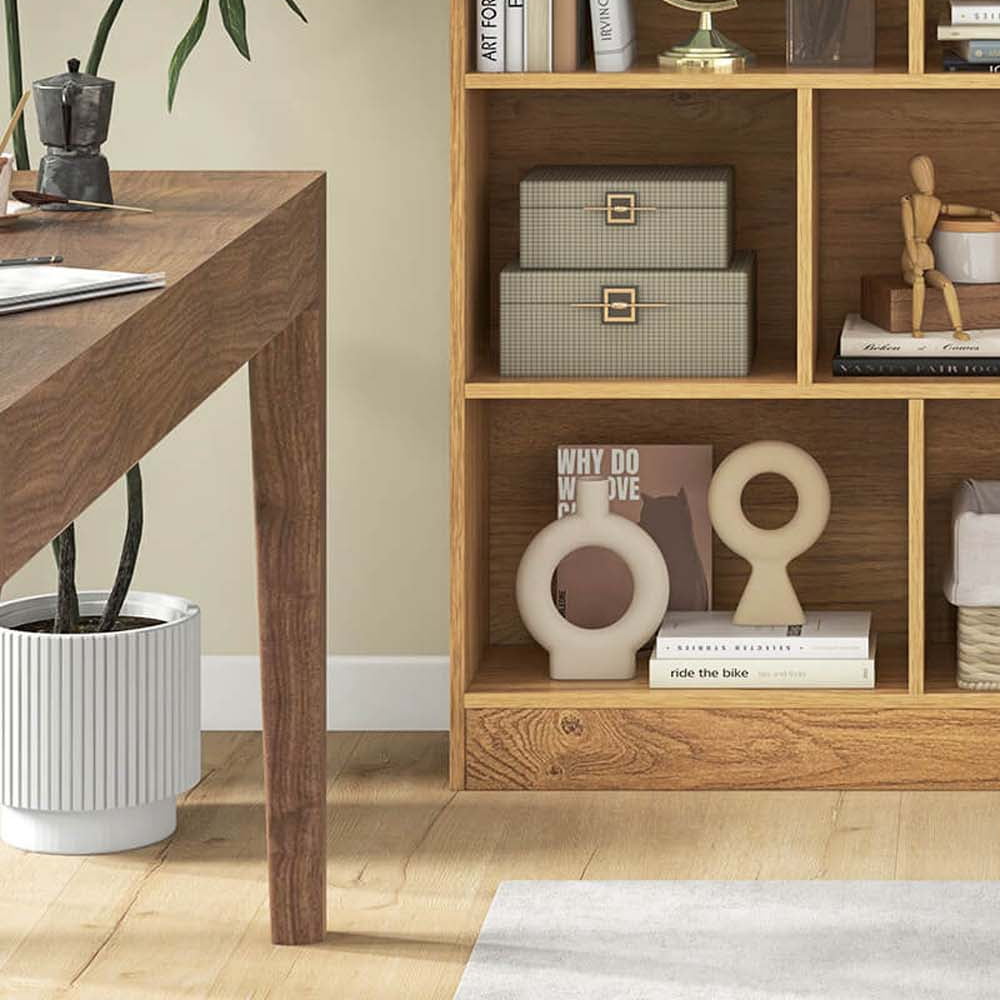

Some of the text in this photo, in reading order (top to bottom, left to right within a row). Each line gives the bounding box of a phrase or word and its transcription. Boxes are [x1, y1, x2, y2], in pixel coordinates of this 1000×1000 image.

[481, 33, 497, 62] ART
[558, 448, 639, 474] WHY DO
[608, 476, 640, 500] OVE
[670, 667, 695, 679] ride
[699, 667, 720, 679] the
[722, 667, 749, 679] bike
